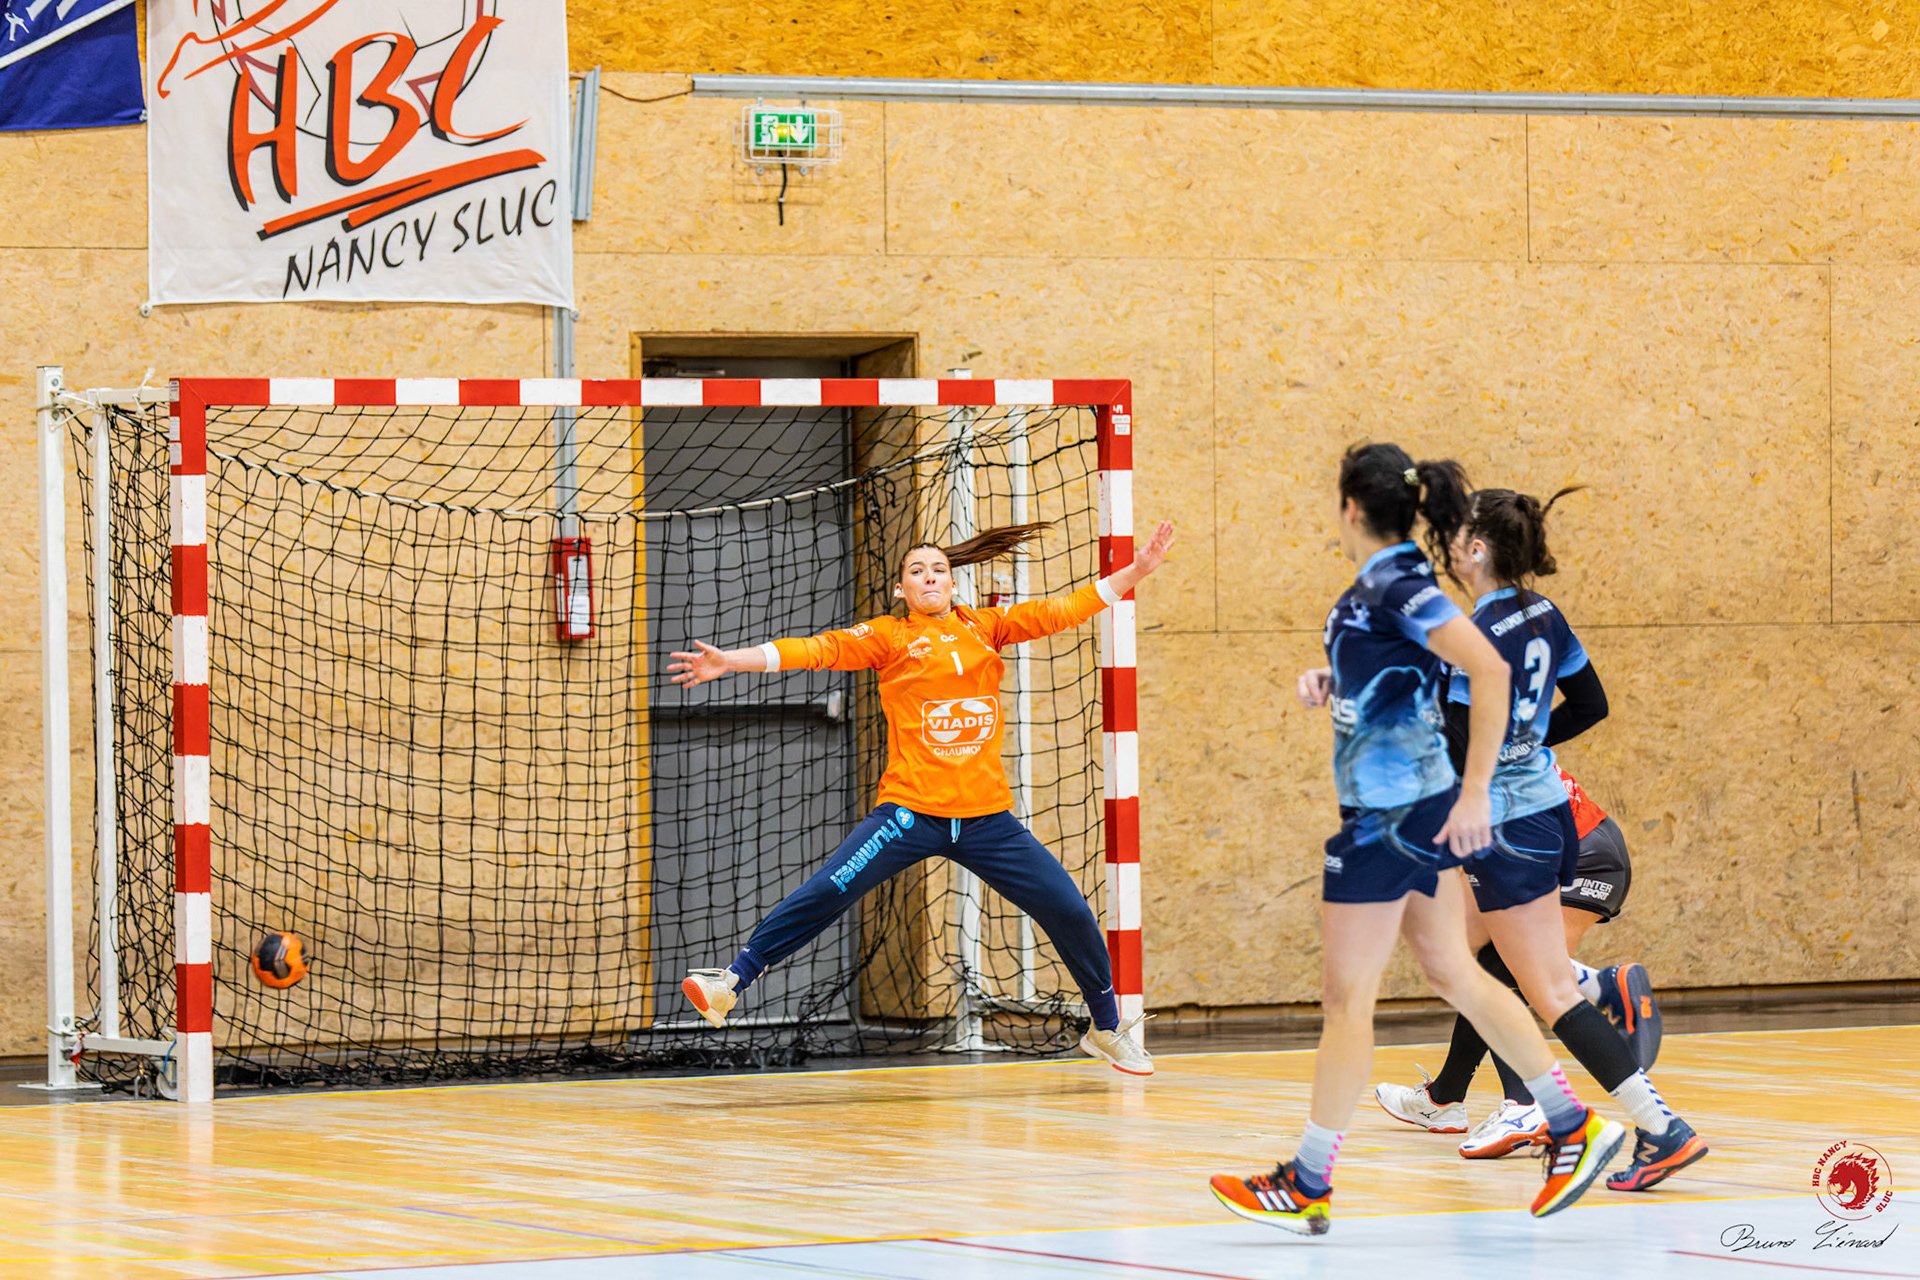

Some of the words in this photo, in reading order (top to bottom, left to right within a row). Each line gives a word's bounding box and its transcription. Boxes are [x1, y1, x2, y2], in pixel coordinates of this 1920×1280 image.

[227, 16, 531, 212] HBC
[283, 211, 437, 299] NANCY
[453, 180, 557, 253] SLUC
[950, 651, 963, 676] 1
[1516, 636, 1552, 722] 3
[927, 714, 994, 730] VIADIS
[933, 745, 982, 757] CHAUMO
[1580, 887, 1610, 901] SPORT
[1582, 878, 1613, 894] INTER
